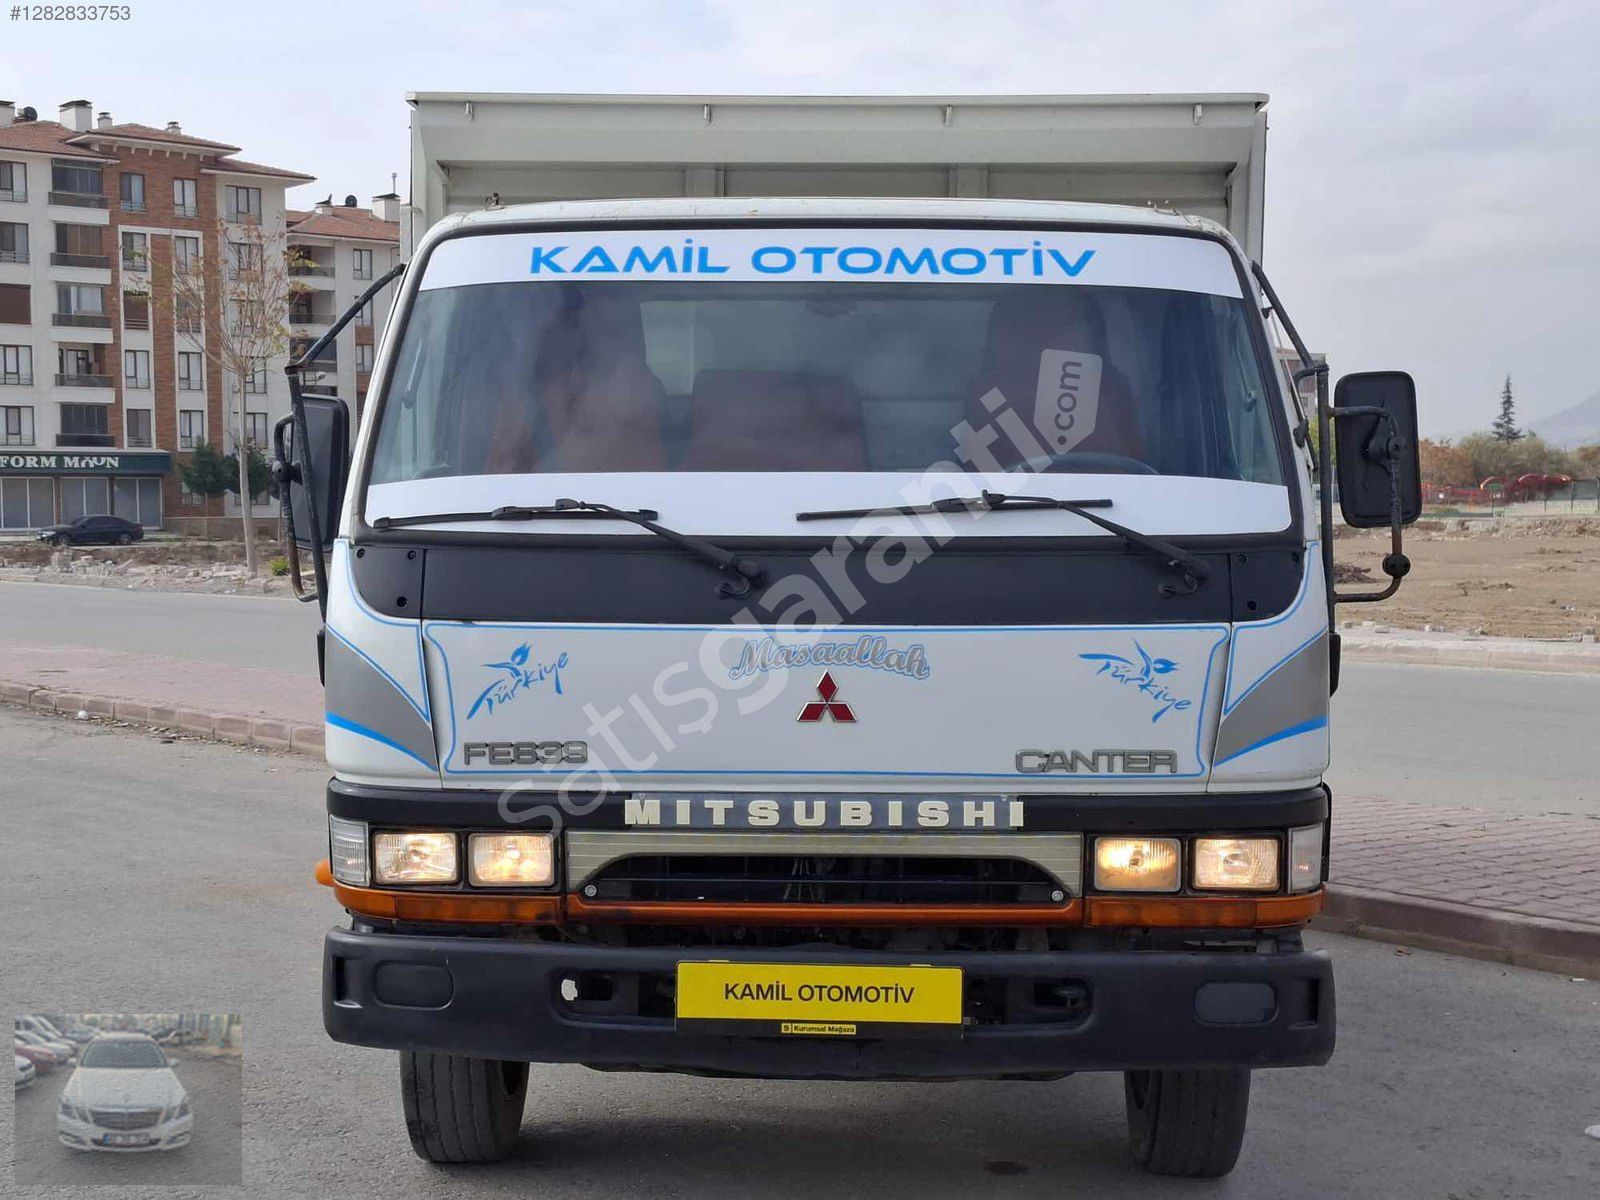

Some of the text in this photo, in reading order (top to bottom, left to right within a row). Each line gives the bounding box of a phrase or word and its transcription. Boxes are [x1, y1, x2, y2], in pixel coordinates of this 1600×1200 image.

[529, 238, 1096, 277] KAMİL OTOMOTİV
[463, 740, 588, 766] FE639
[1015, 749, 1178, 774] CANTER
[624, 799, 1024, 827] MITSUBISHI
[724, 980, 915, 1004] KAMİL OTOMOTİV
[794, 1024, 826, 1032] Kurumsal
[828, 1025, 855, 1034] Mağaza
